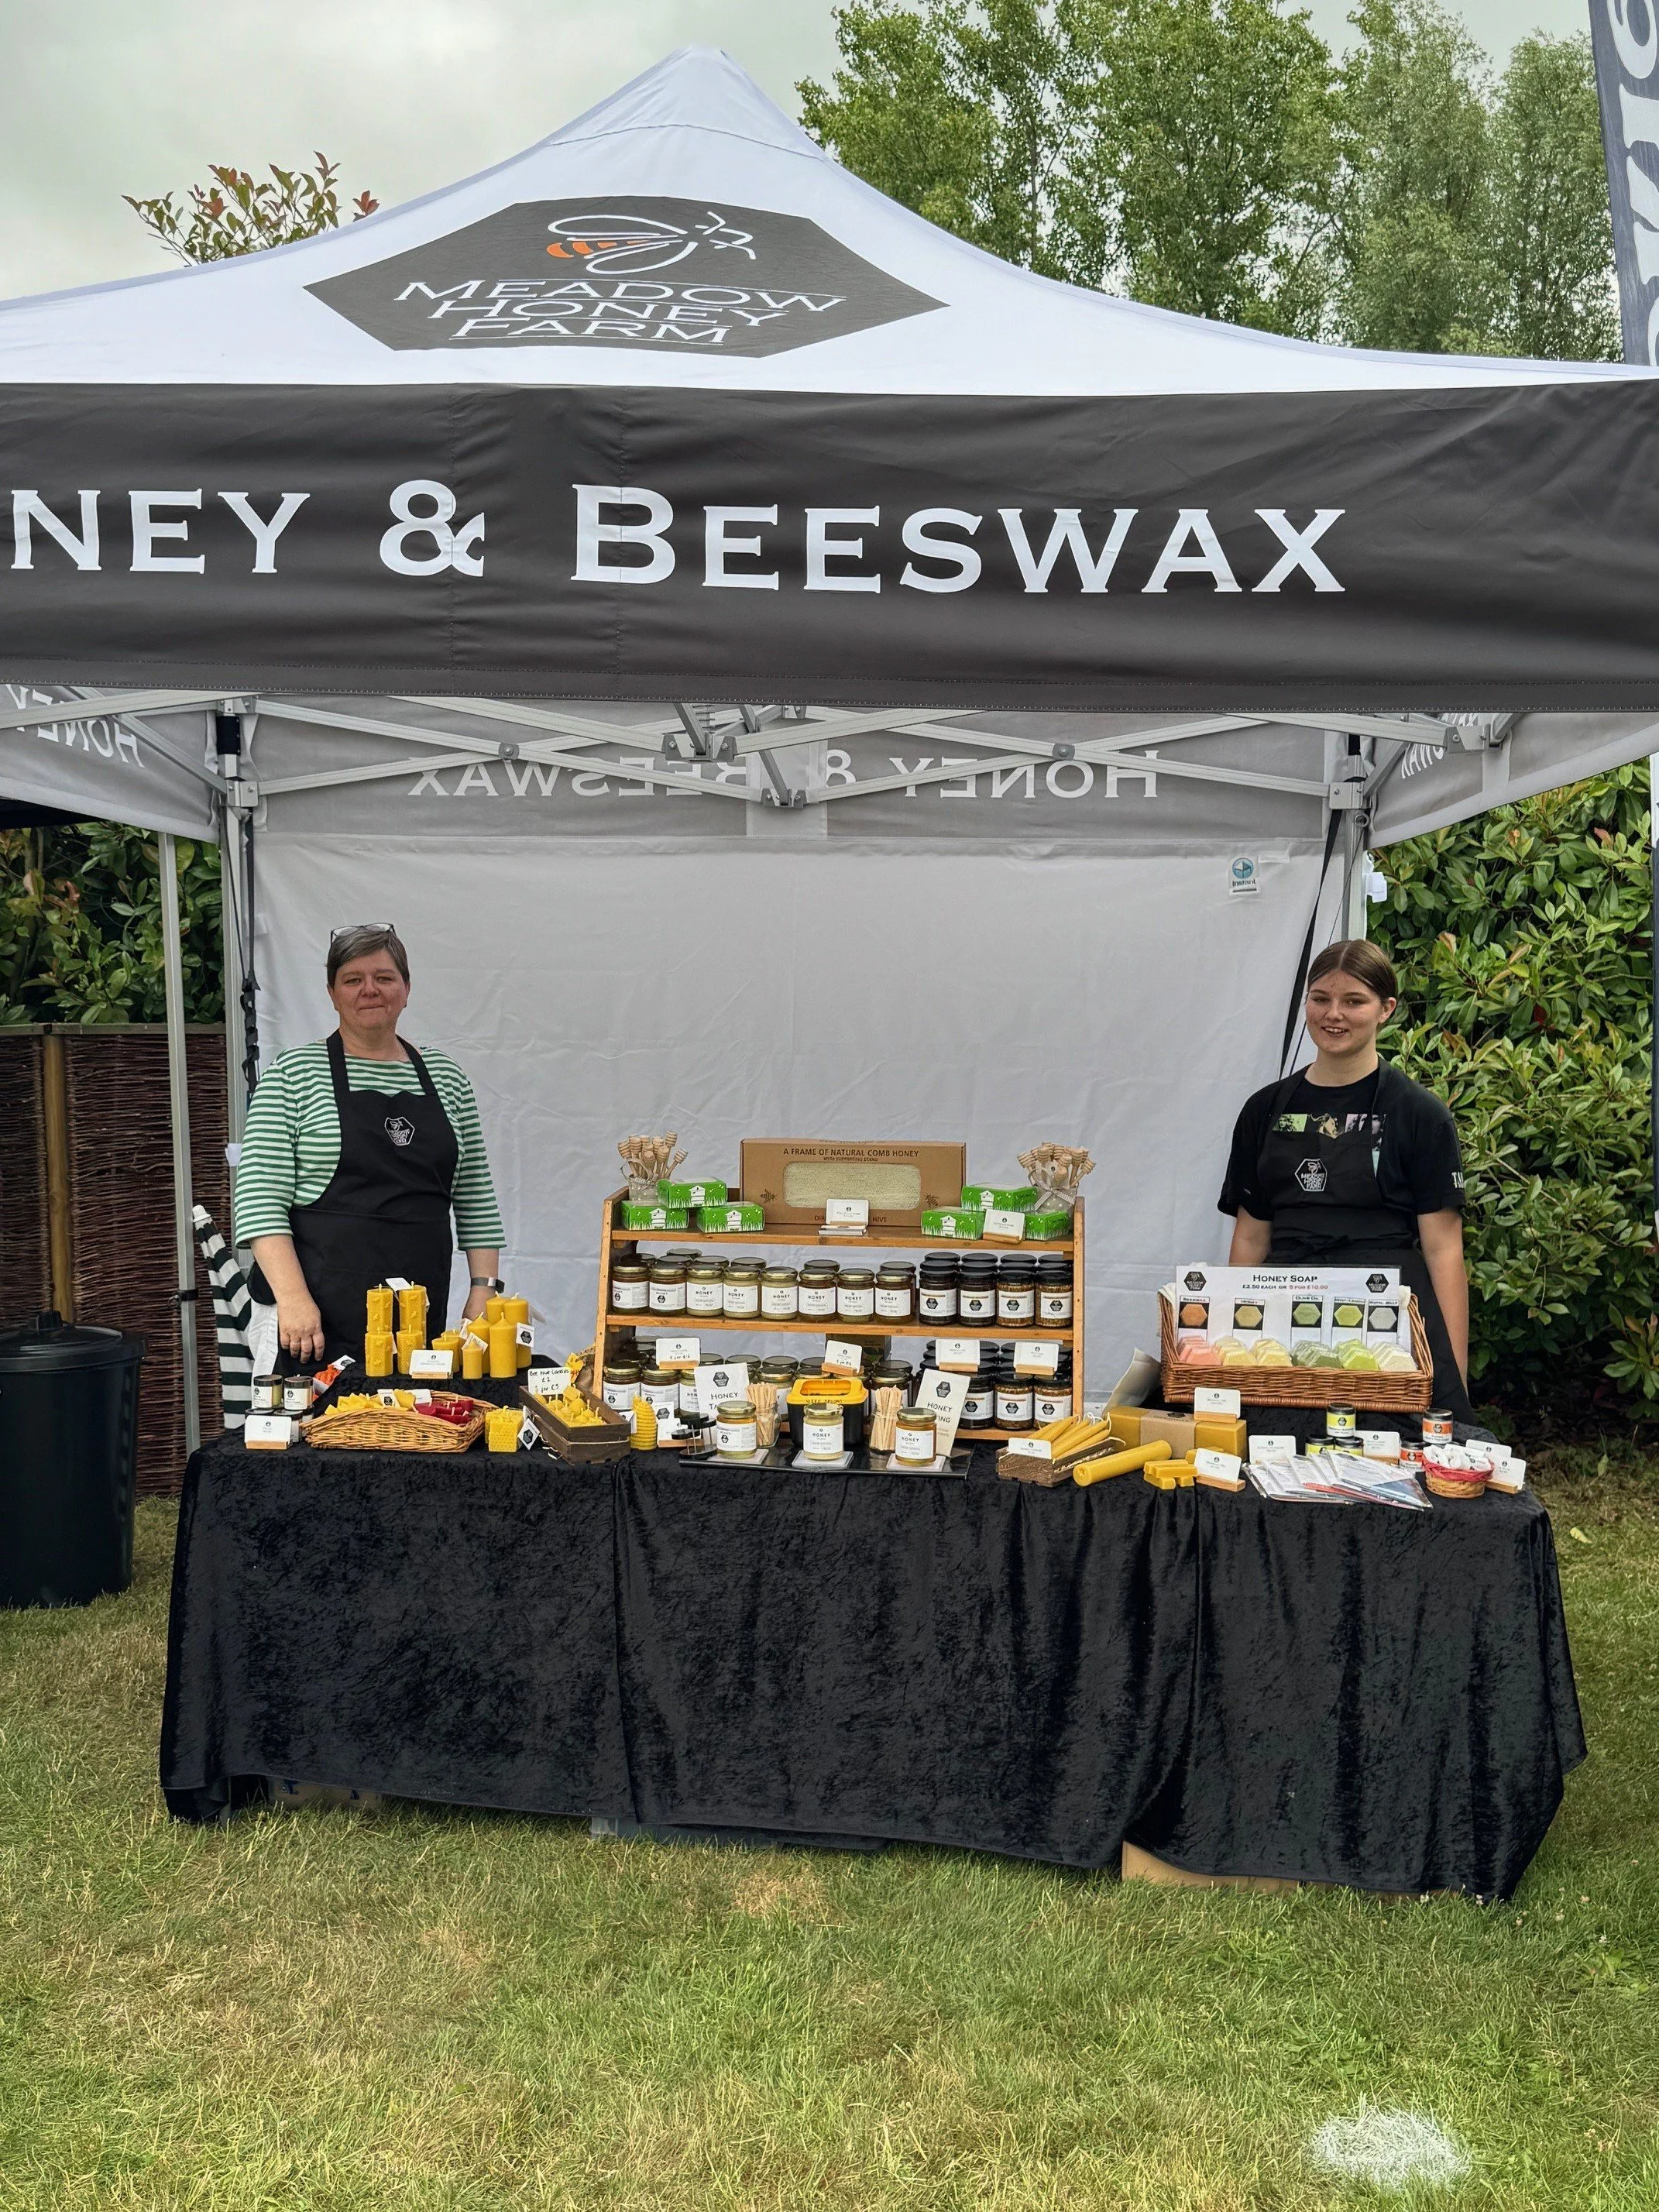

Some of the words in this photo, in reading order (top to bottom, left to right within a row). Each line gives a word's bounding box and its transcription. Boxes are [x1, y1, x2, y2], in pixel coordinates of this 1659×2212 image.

[393, 280, 847, 311] MEADOW
[428, 299, 789, 327] HONEY
[452, 318, 730, 344] FARM
[380, 479, 484, 576] &
[572, 483, 1346, 595] BEESWAX
[1253, 1274, 1288, 1283] HONEY
[710, 1392, 738, 1400] HONEY
[927, 1402, 953, 1413] HONEY
